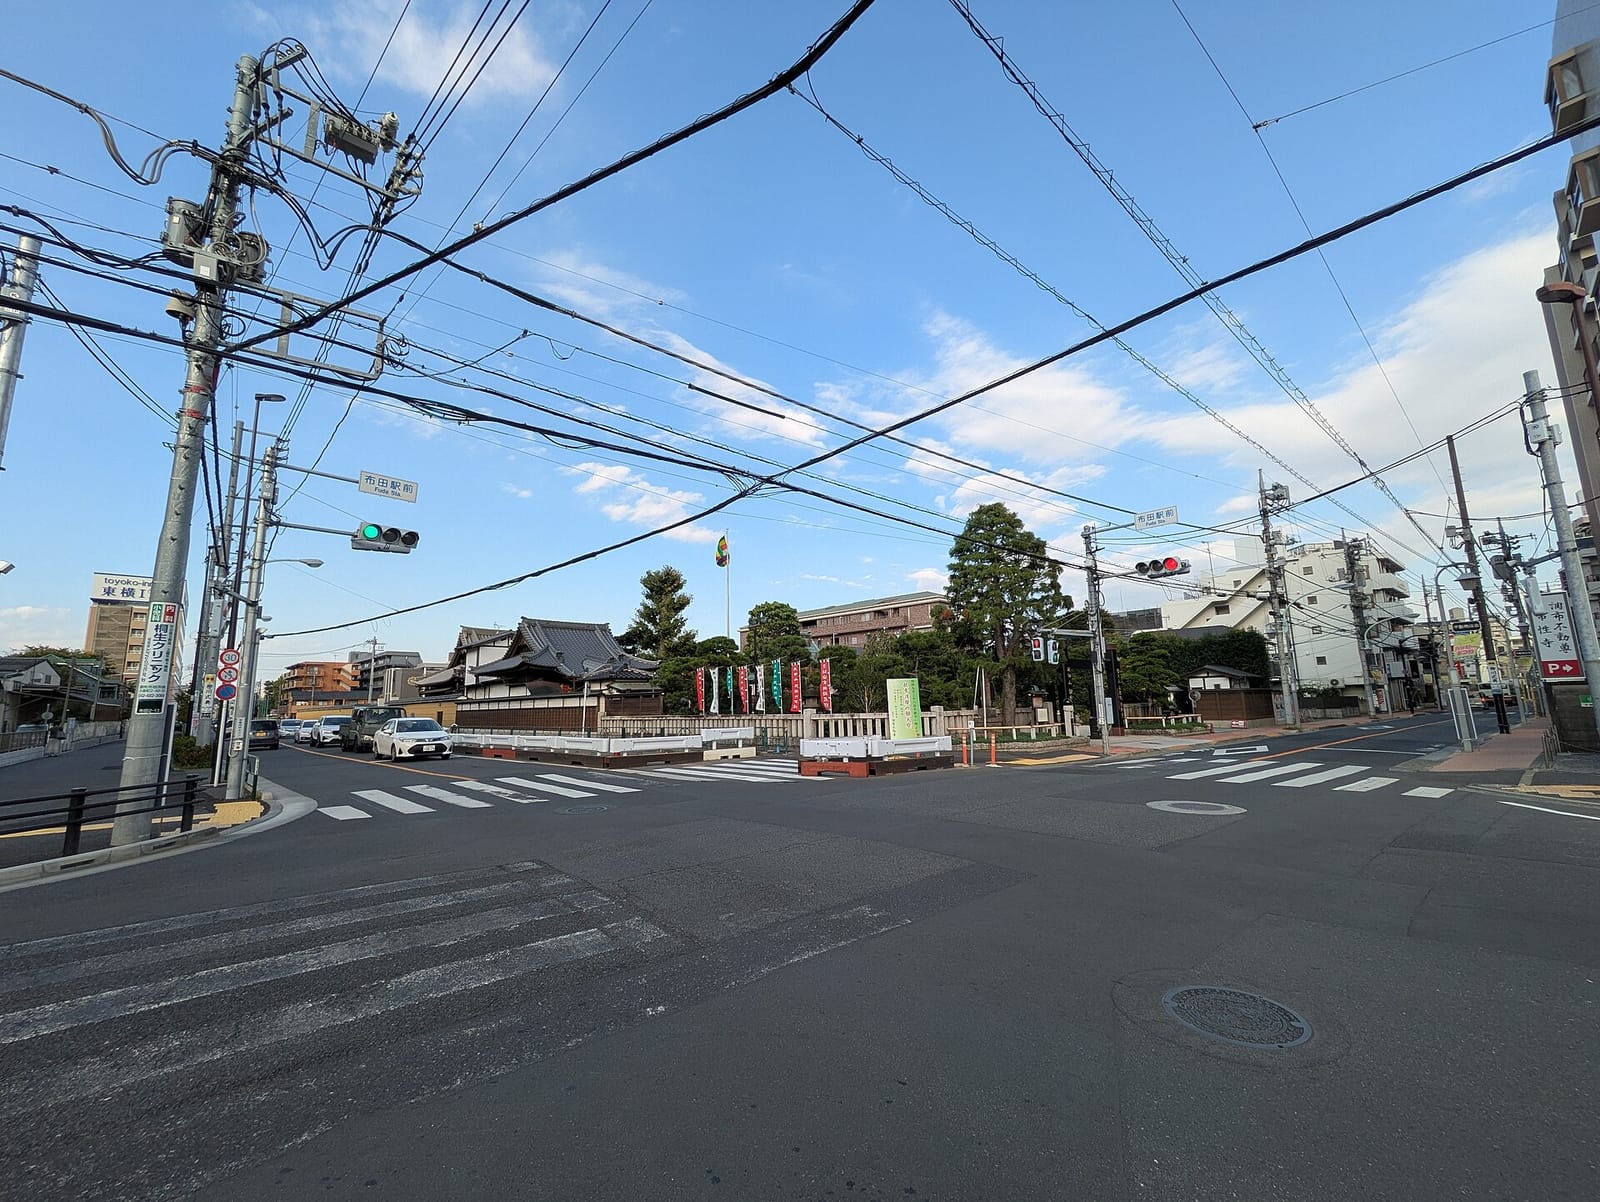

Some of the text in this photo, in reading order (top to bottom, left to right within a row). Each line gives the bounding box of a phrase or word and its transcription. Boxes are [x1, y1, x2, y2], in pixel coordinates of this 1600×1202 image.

[364, 475, 413, 493] 布田駅前
[1137, 509, 1174, 523] 布田駅前
[101, 586, 151, 599] 東横I
[164, 605, 175, 622] 内科
[1548, 602, 1573, 653] 調布不動尊
[148, 624, 169, 683] 桐生クリニック
[224, 654, 237, 662] 30
[1548, 664, 1560, 674] P
